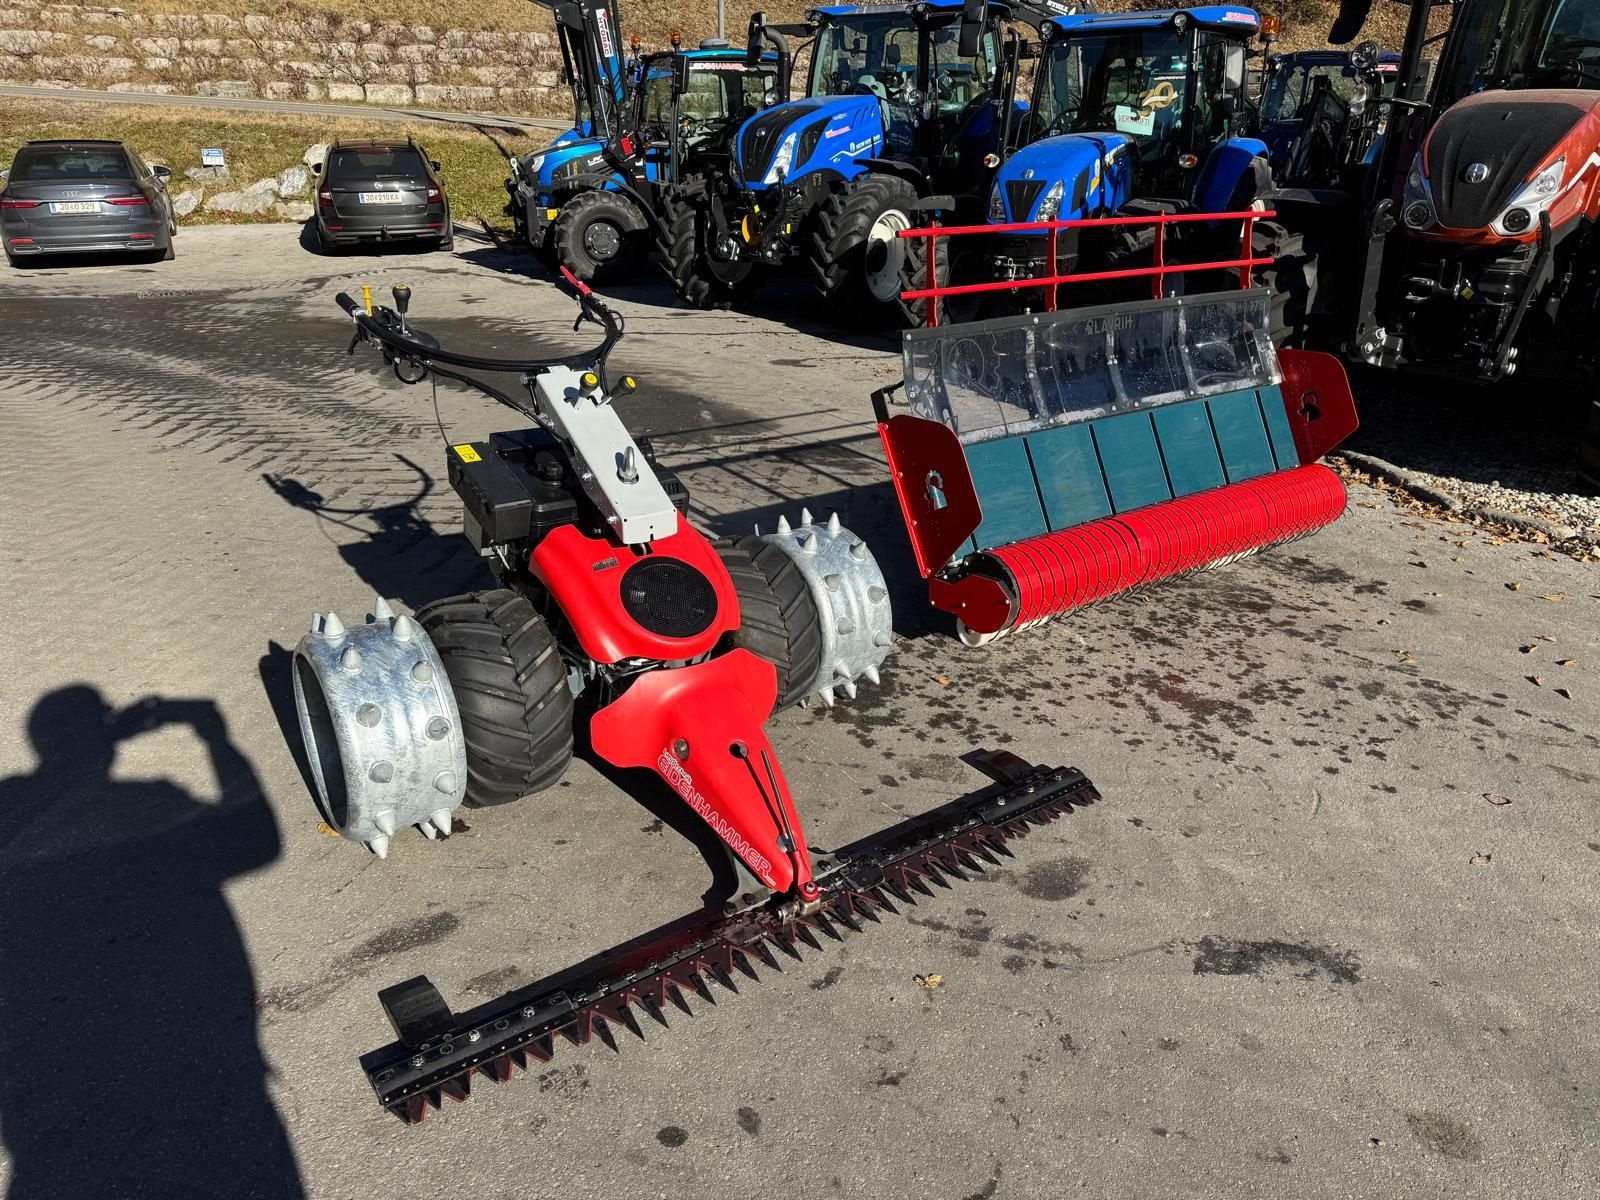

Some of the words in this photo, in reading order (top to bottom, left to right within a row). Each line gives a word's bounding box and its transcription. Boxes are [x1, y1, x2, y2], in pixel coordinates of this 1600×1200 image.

[597, 17, 609, 55] HYDRAC
[1094, 315, 1134, 335] LAVRIH
[658, 754, 773, 878] EIDENHAMMER
